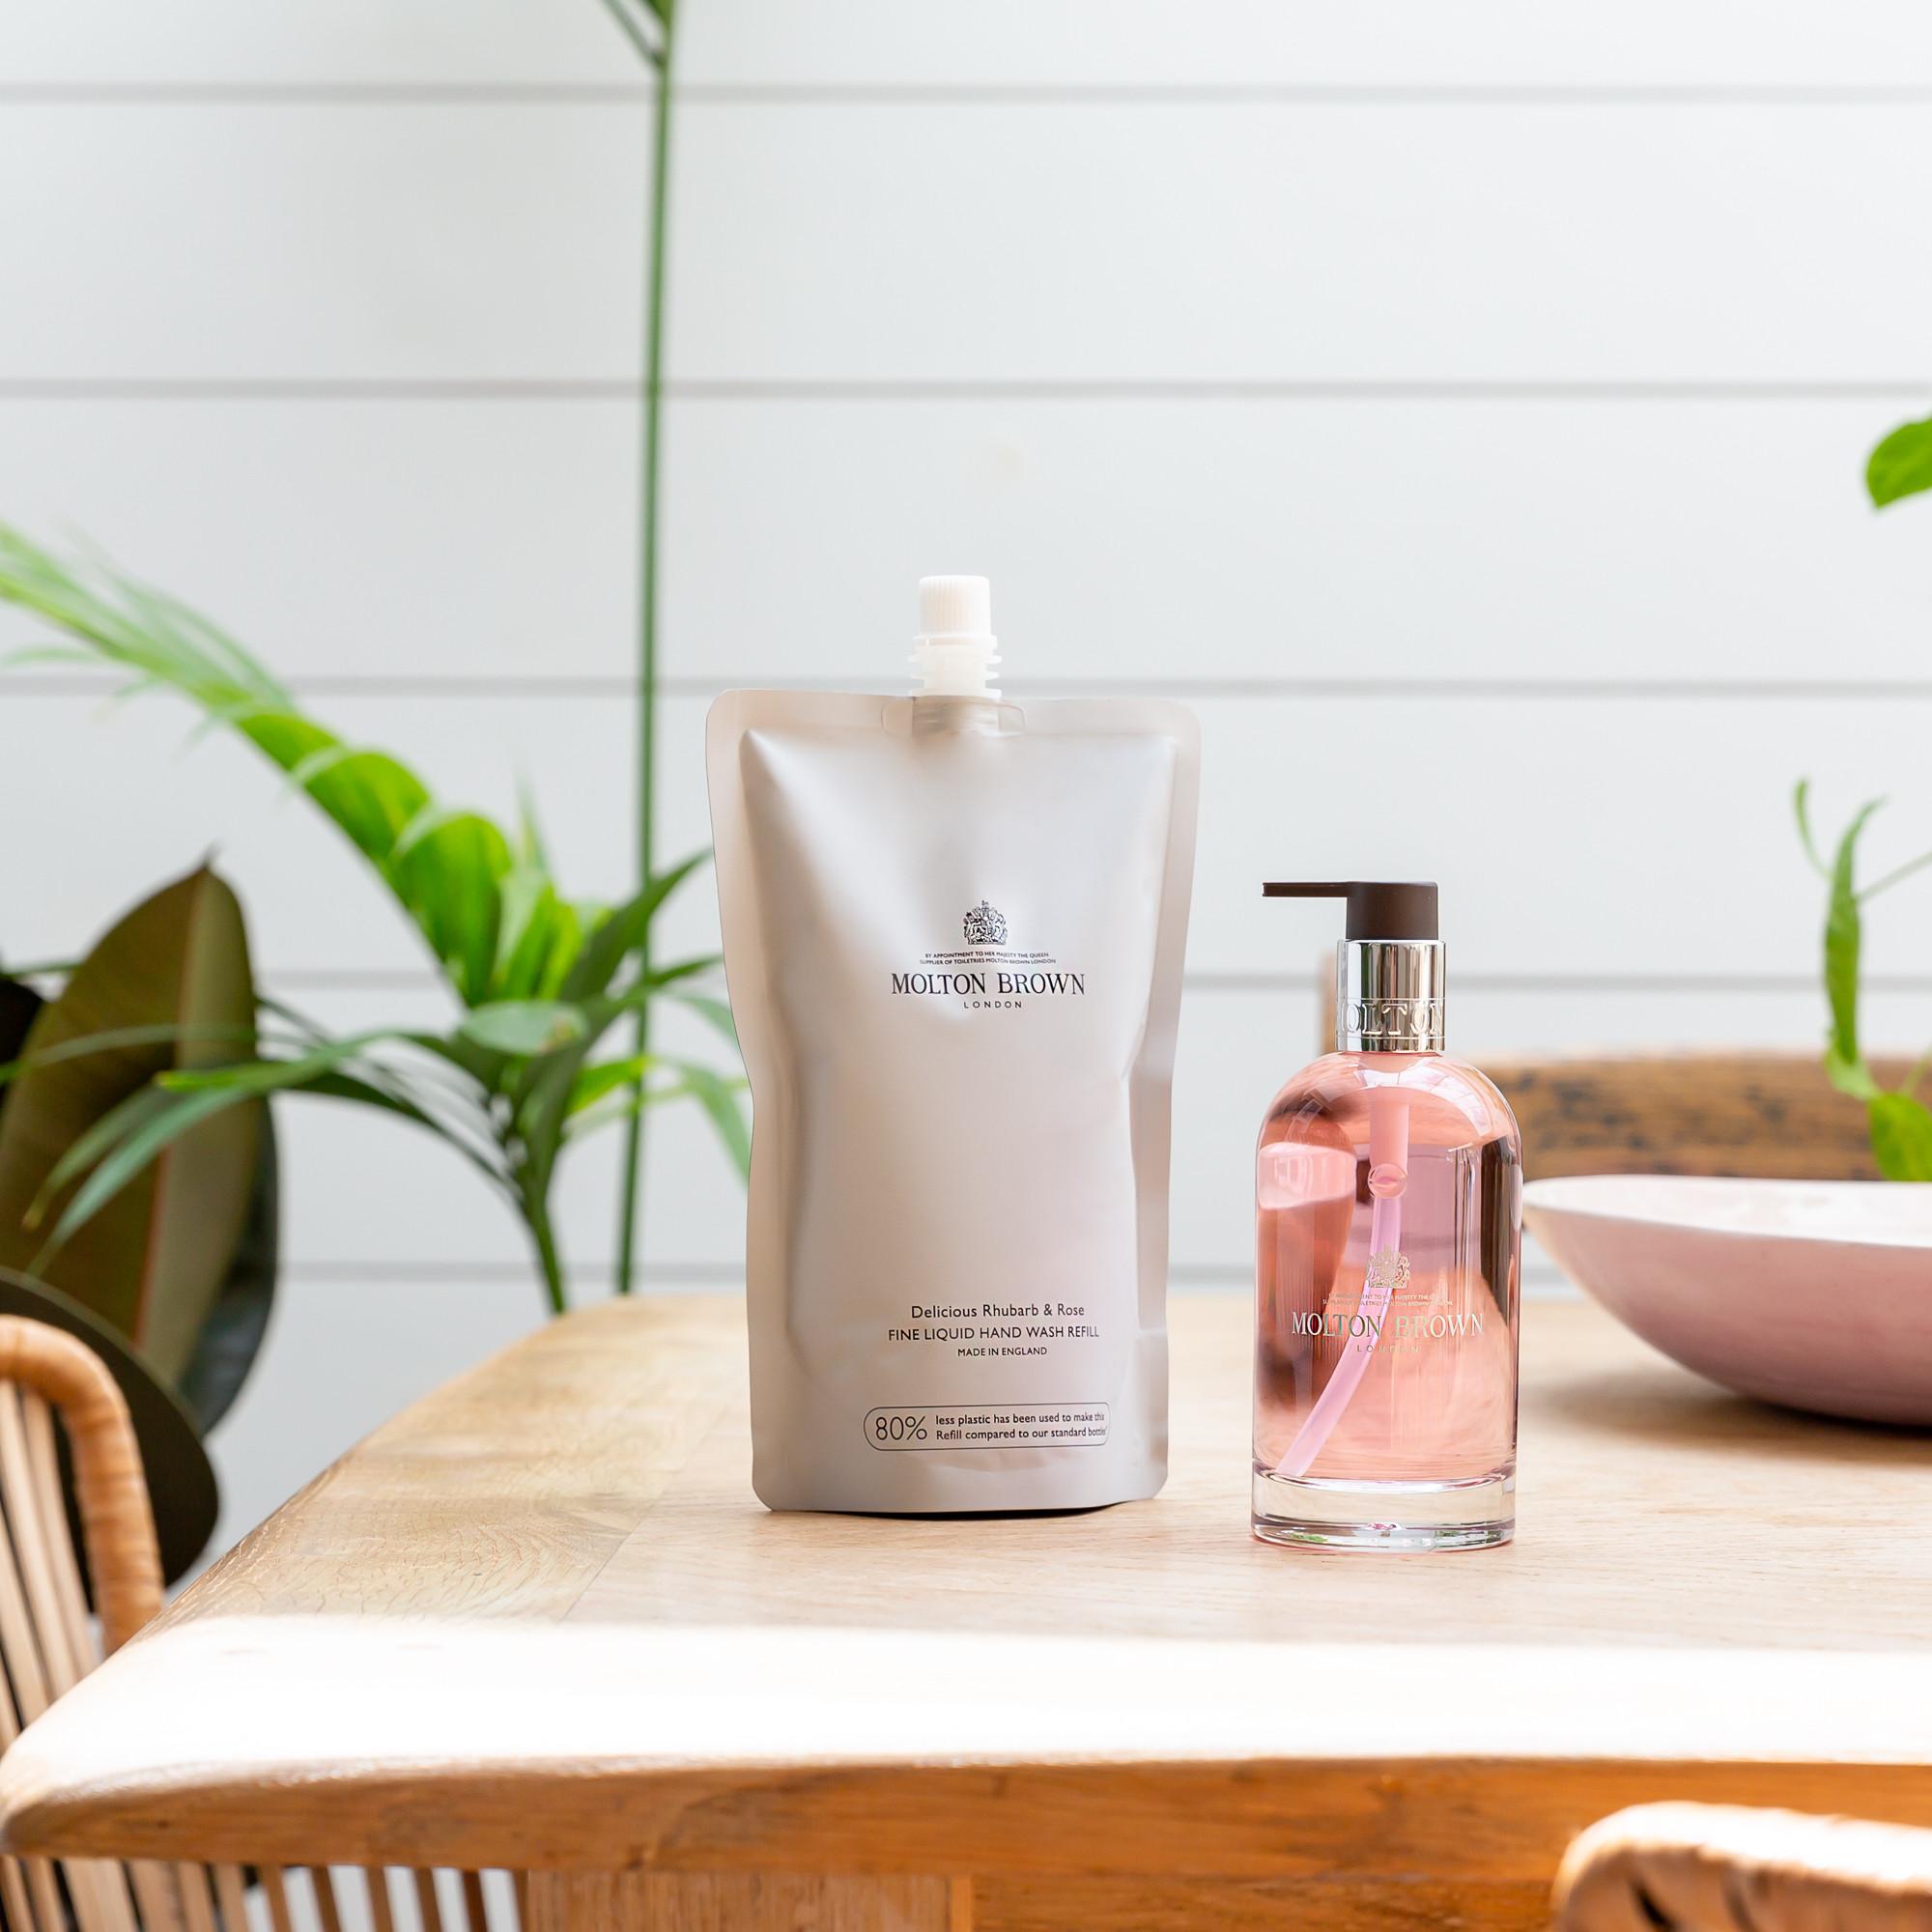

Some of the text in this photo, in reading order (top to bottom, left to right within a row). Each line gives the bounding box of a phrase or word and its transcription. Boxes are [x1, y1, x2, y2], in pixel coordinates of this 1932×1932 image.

[892, 973, 1085, 995] MOLTON BROWN
[911, 1304, 1085, 1319] Delicious Rhubarb & Rose
[1292, 1312, 1483, 1339] MOLTON BROWN
[888, 1326, 1099, 1342] FINE LIQUID HAND WASH REFILL
[988, 1348, 999, 1356] IN
[1002, 1347, 1047, 1356] ENGLAND
[935, 1414, 954, 1425] less
[958, 1414, 990, 1427] plastic
[993, 1414, 1009, 1424] has
[1012, 1413, 1036, 1424] been
[1038, 1412, 1060, 1423] used
[1073, 1411, 1093, 1421] make
[875, 1415, 927, 1441] 80%
[936, 1430, 962, 1440] Refill
[965, 1429, 1015, 1441] compared
[1018, 1430, 1029, 1438] to
[1050, 1427, 1086, 1437] standard
